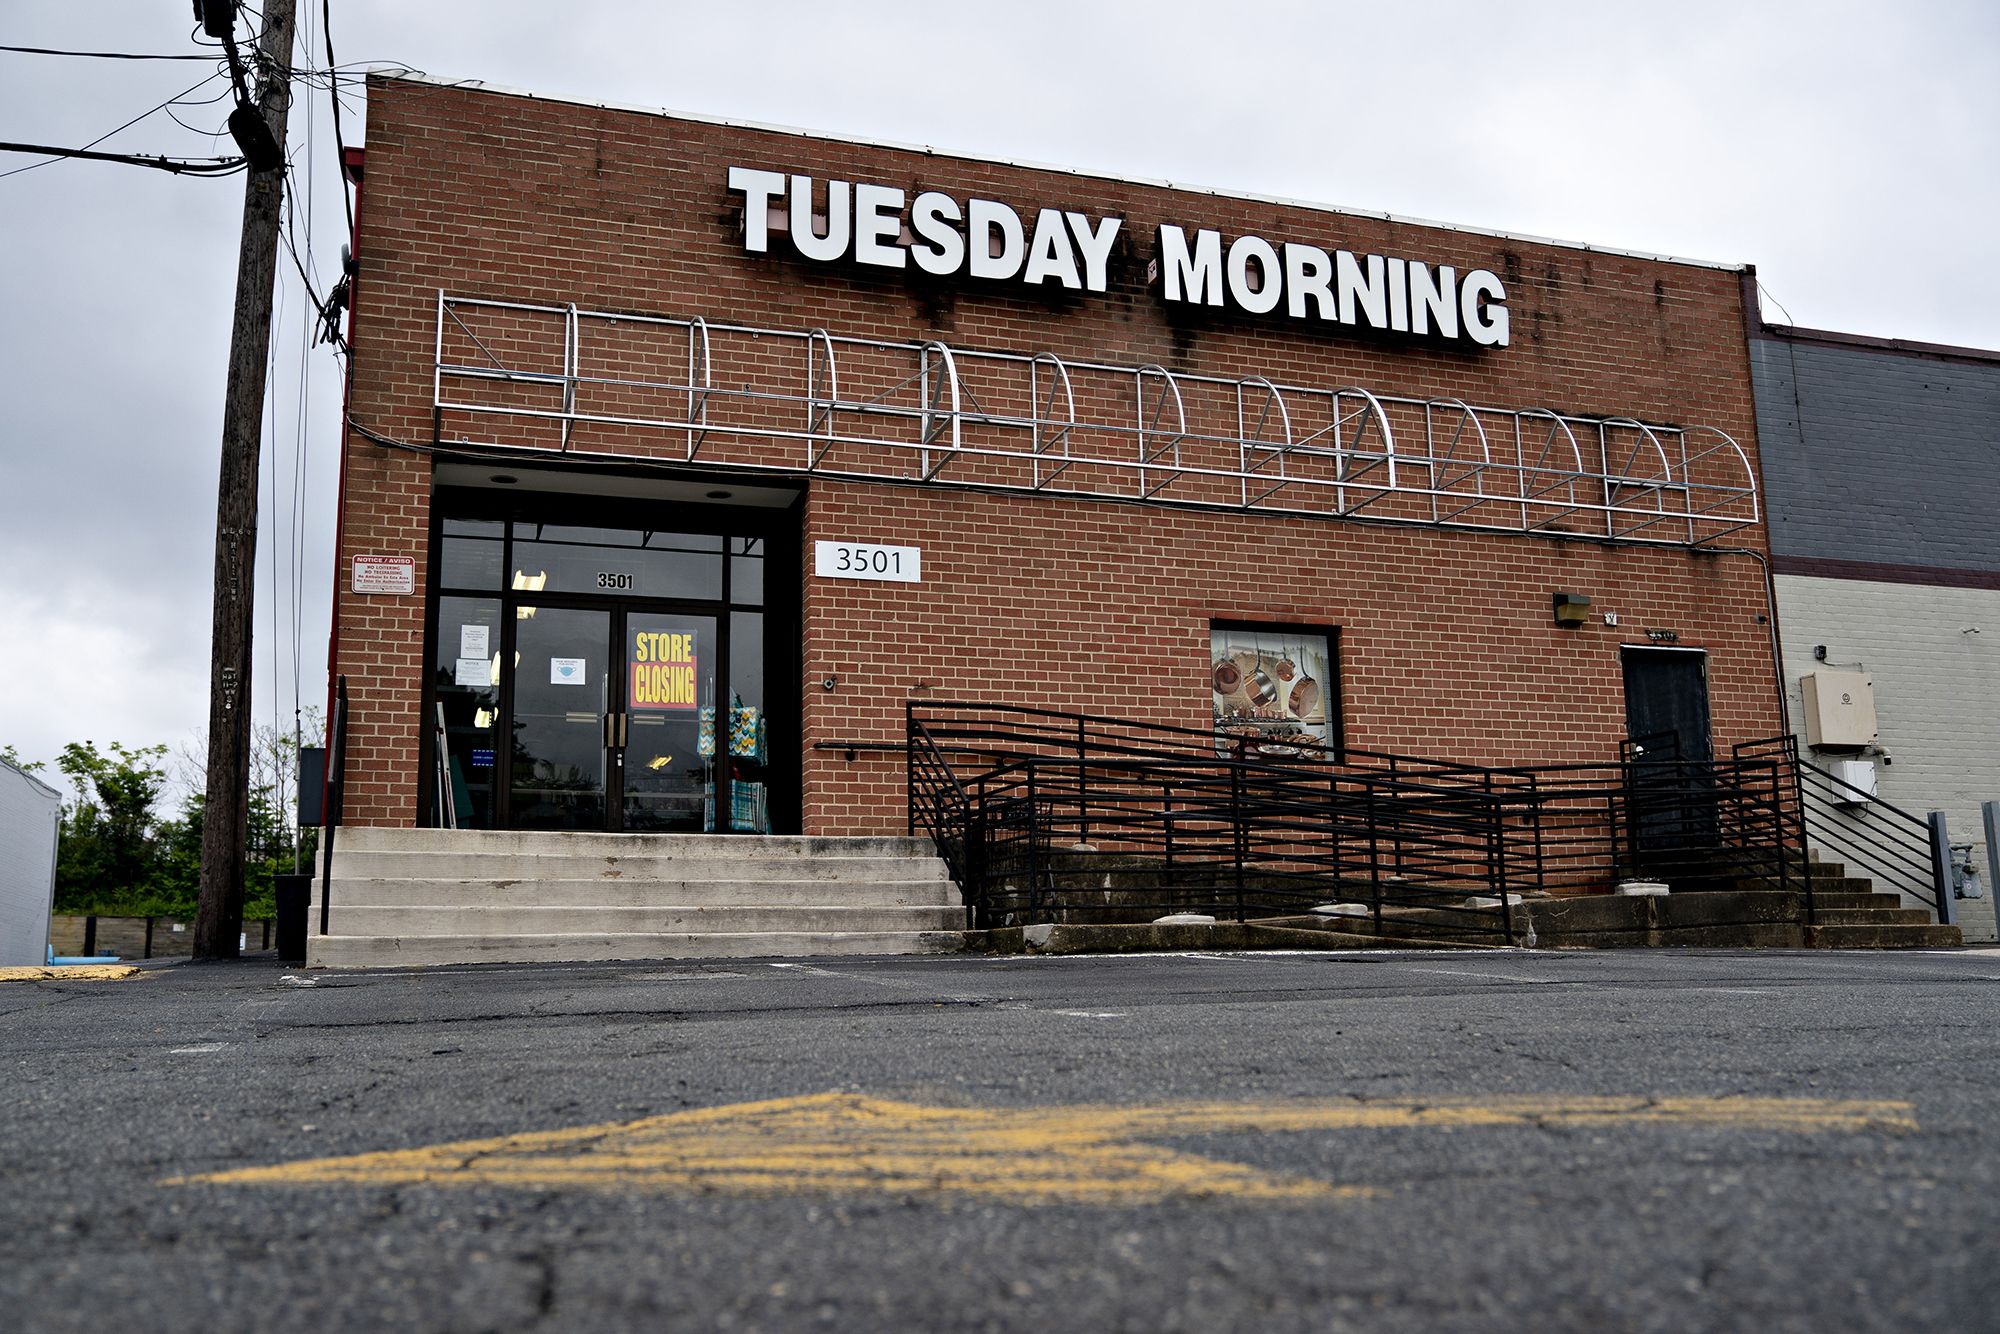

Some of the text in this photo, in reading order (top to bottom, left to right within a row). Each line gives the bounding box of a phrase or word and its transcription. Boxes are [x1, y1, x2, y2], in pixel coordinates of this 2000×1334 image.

[728, 166, 1511, 346] TUESDAY MORNING
[836, 547, 900, 574] 3501
[598, 572, 634, 590] 3501
[636, 632, 692, 663] STORE
[635, 664, 695, 704] CLOSING
